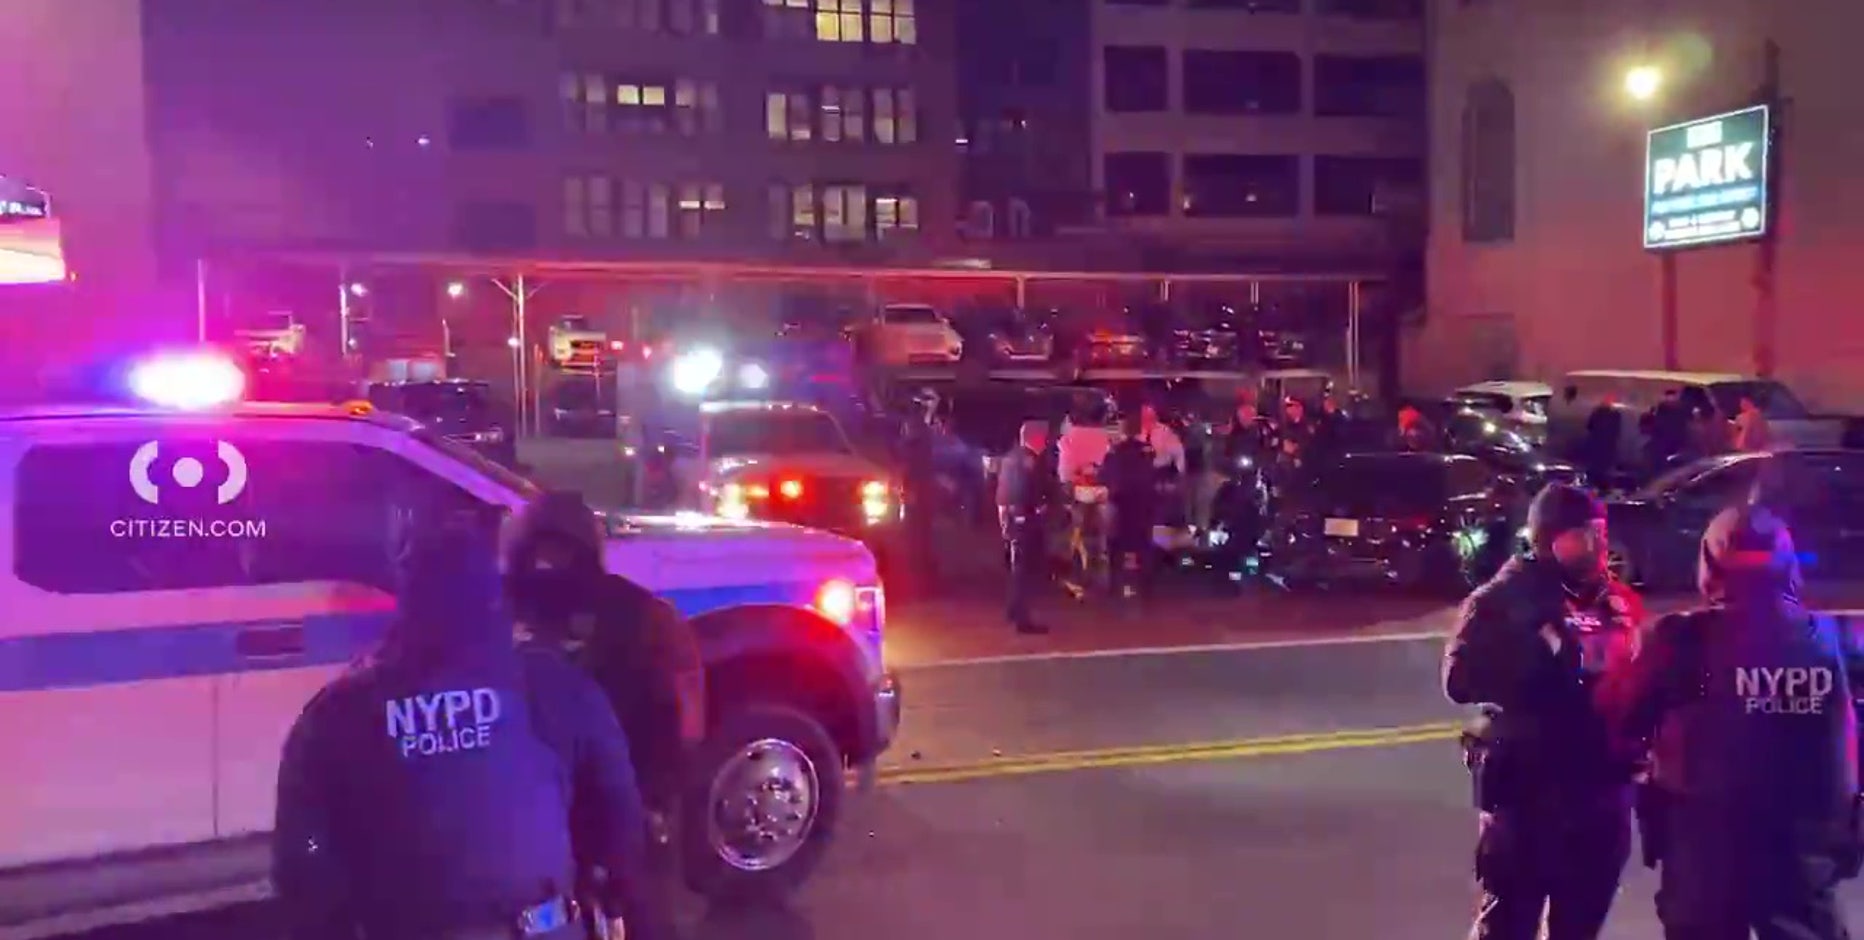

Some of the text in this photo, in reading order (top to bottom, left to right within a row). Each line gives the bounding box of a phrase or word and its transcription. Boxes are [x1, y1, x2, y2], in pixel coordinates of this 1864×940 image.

[1653, 142, 1755, 194] PARK
[1736, 667, 1833, 696] NYPD
[386, 687, 500, 738] NYPD
[1745, 696, 1823, 714] POLICE
[402, 725, 490, 758] POLICE
